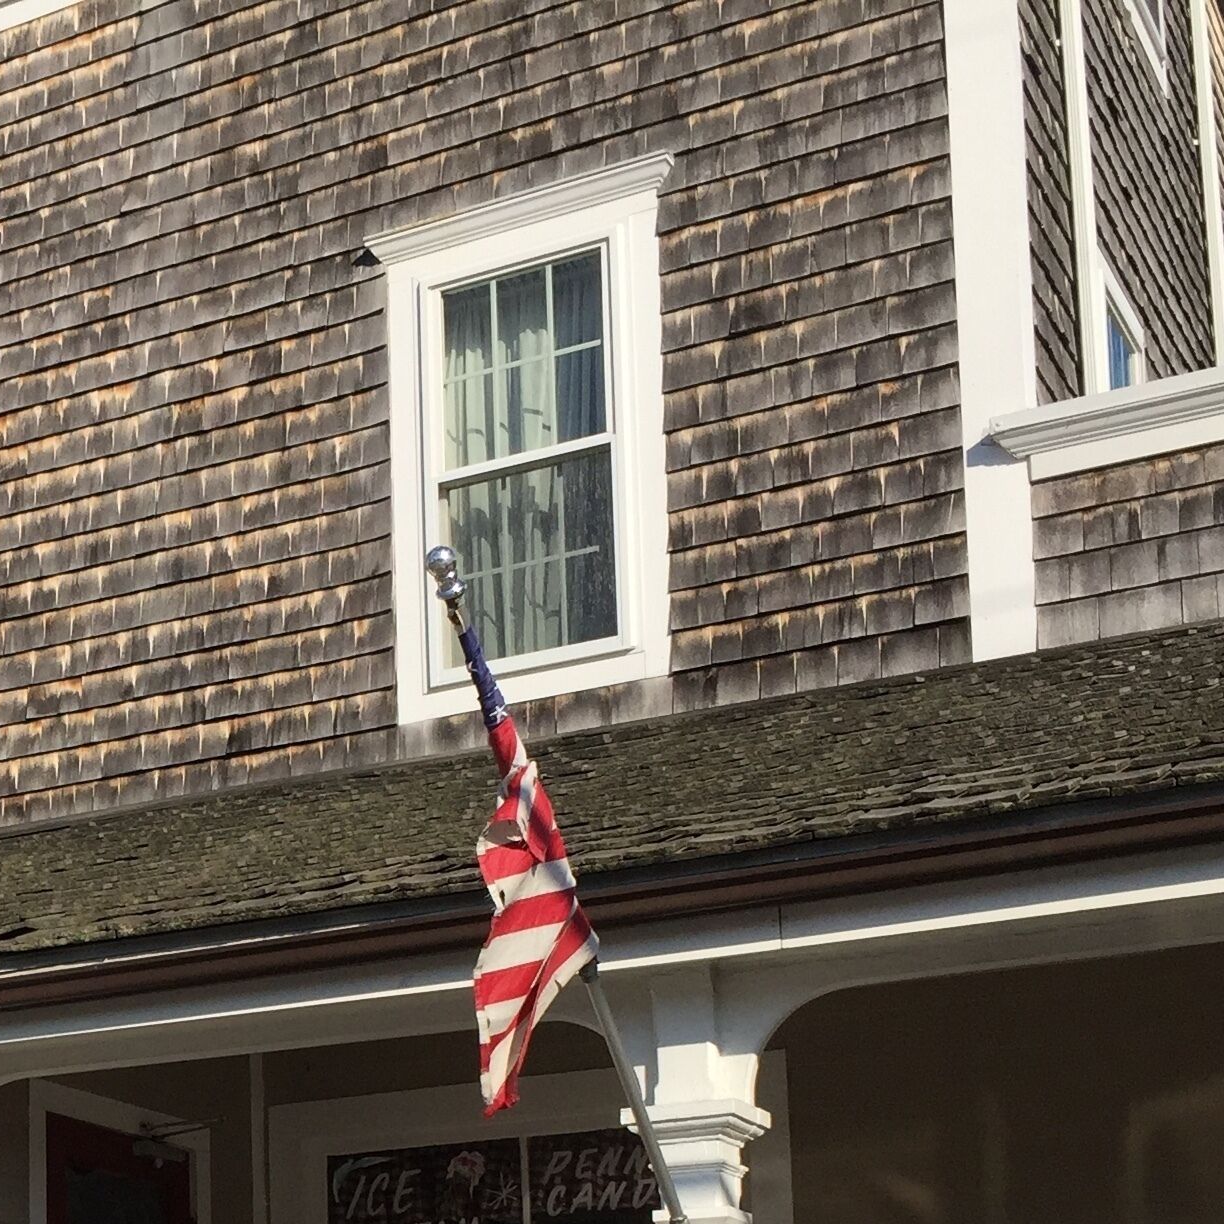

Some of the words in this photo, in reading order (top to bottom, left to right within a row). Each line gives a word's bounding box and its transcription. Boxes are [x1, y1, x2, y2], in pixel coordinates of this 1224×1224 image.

[543, 1144, 649, 1186] PENN
[346, 1168, 422, 1220] ICE
[547, 1178, 658, 1217] CAND
